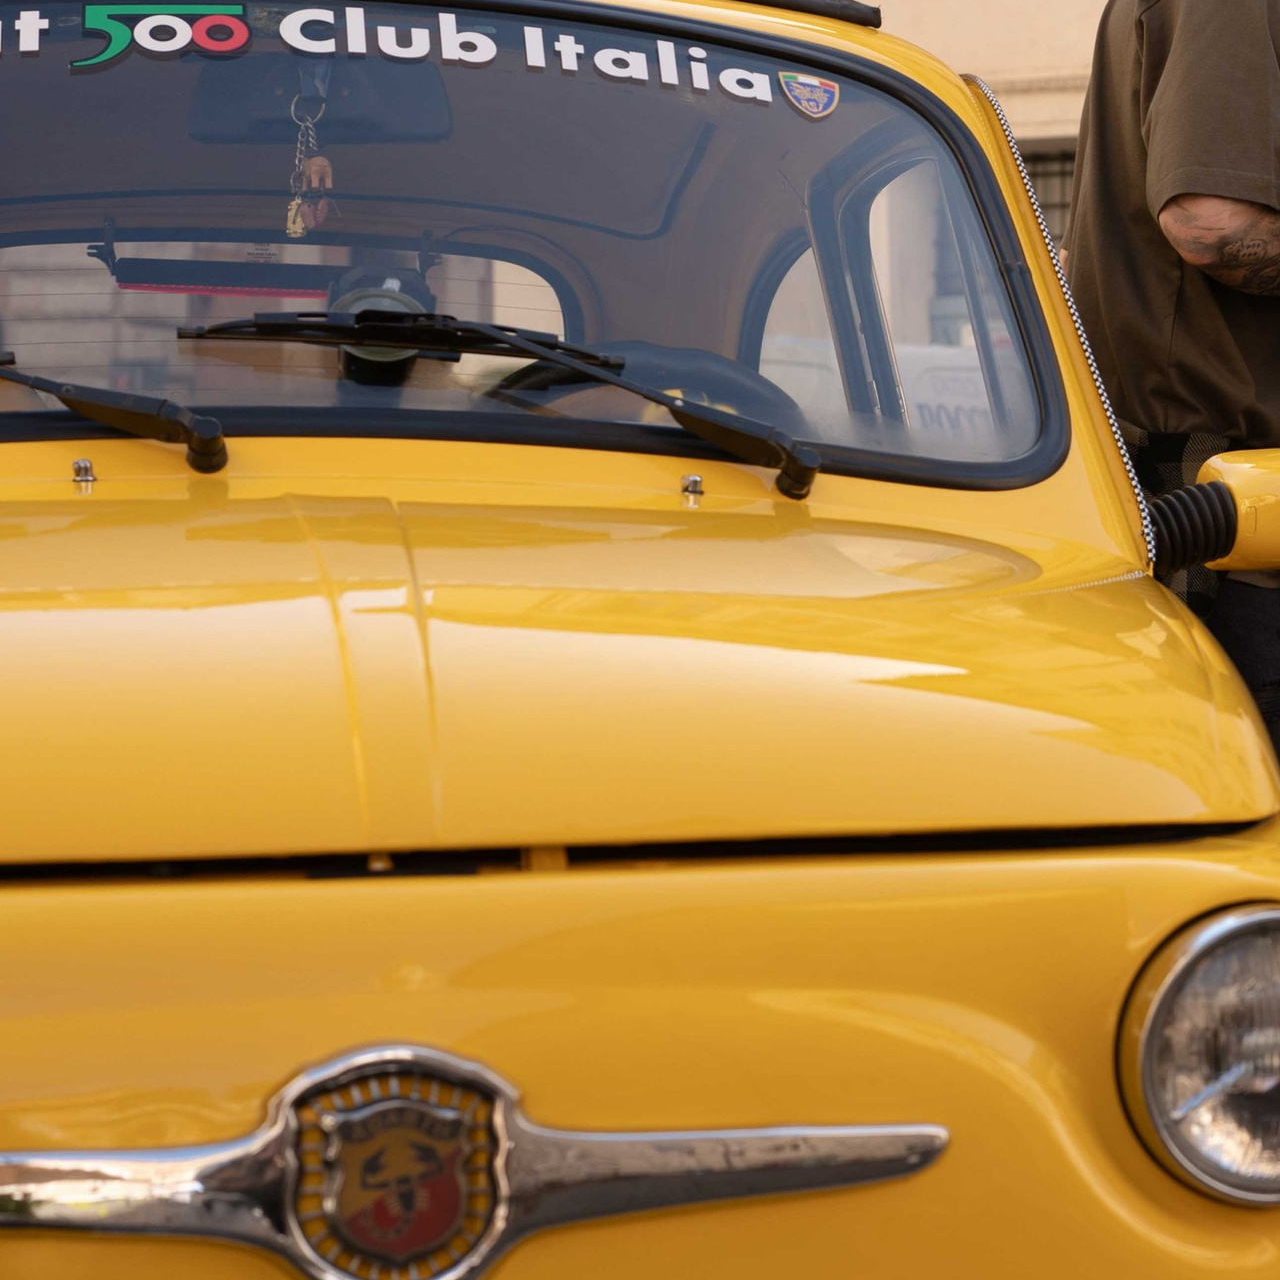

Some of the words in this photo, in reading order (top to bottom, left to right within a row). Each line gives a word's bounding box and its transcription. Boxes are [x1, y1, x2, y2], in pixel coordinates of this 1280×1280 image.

[72, 4, 250, 67] 500
[280, 7, 497, 62] Club
[524, 26, 773, 102] Italia
